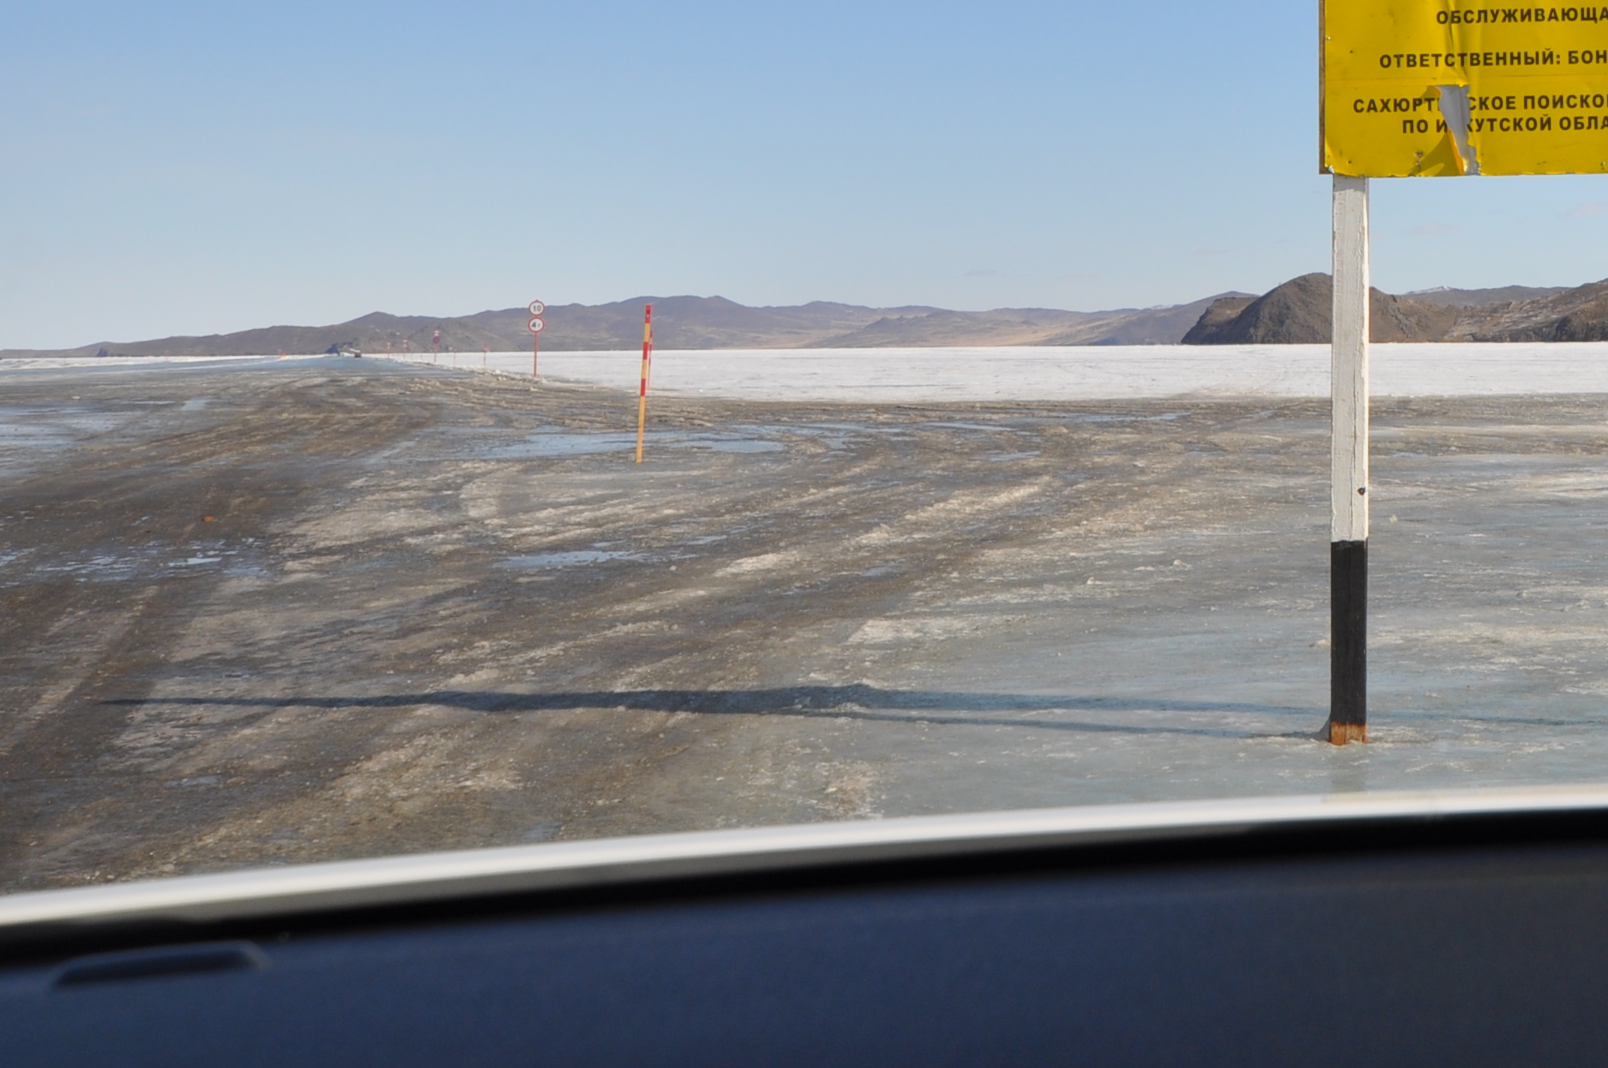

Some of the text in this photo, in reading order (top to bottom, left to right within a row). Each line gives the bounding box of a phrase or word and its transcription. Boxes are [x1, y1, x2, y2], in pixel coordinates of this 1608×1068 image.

[1379, 50, 1561, 69] ОТВЕТСТВЕННЫЙ:
[1352, 95, 1517, 115] САХЮРТСКОЕ
[1402, 119, 1429, 134] ПО
